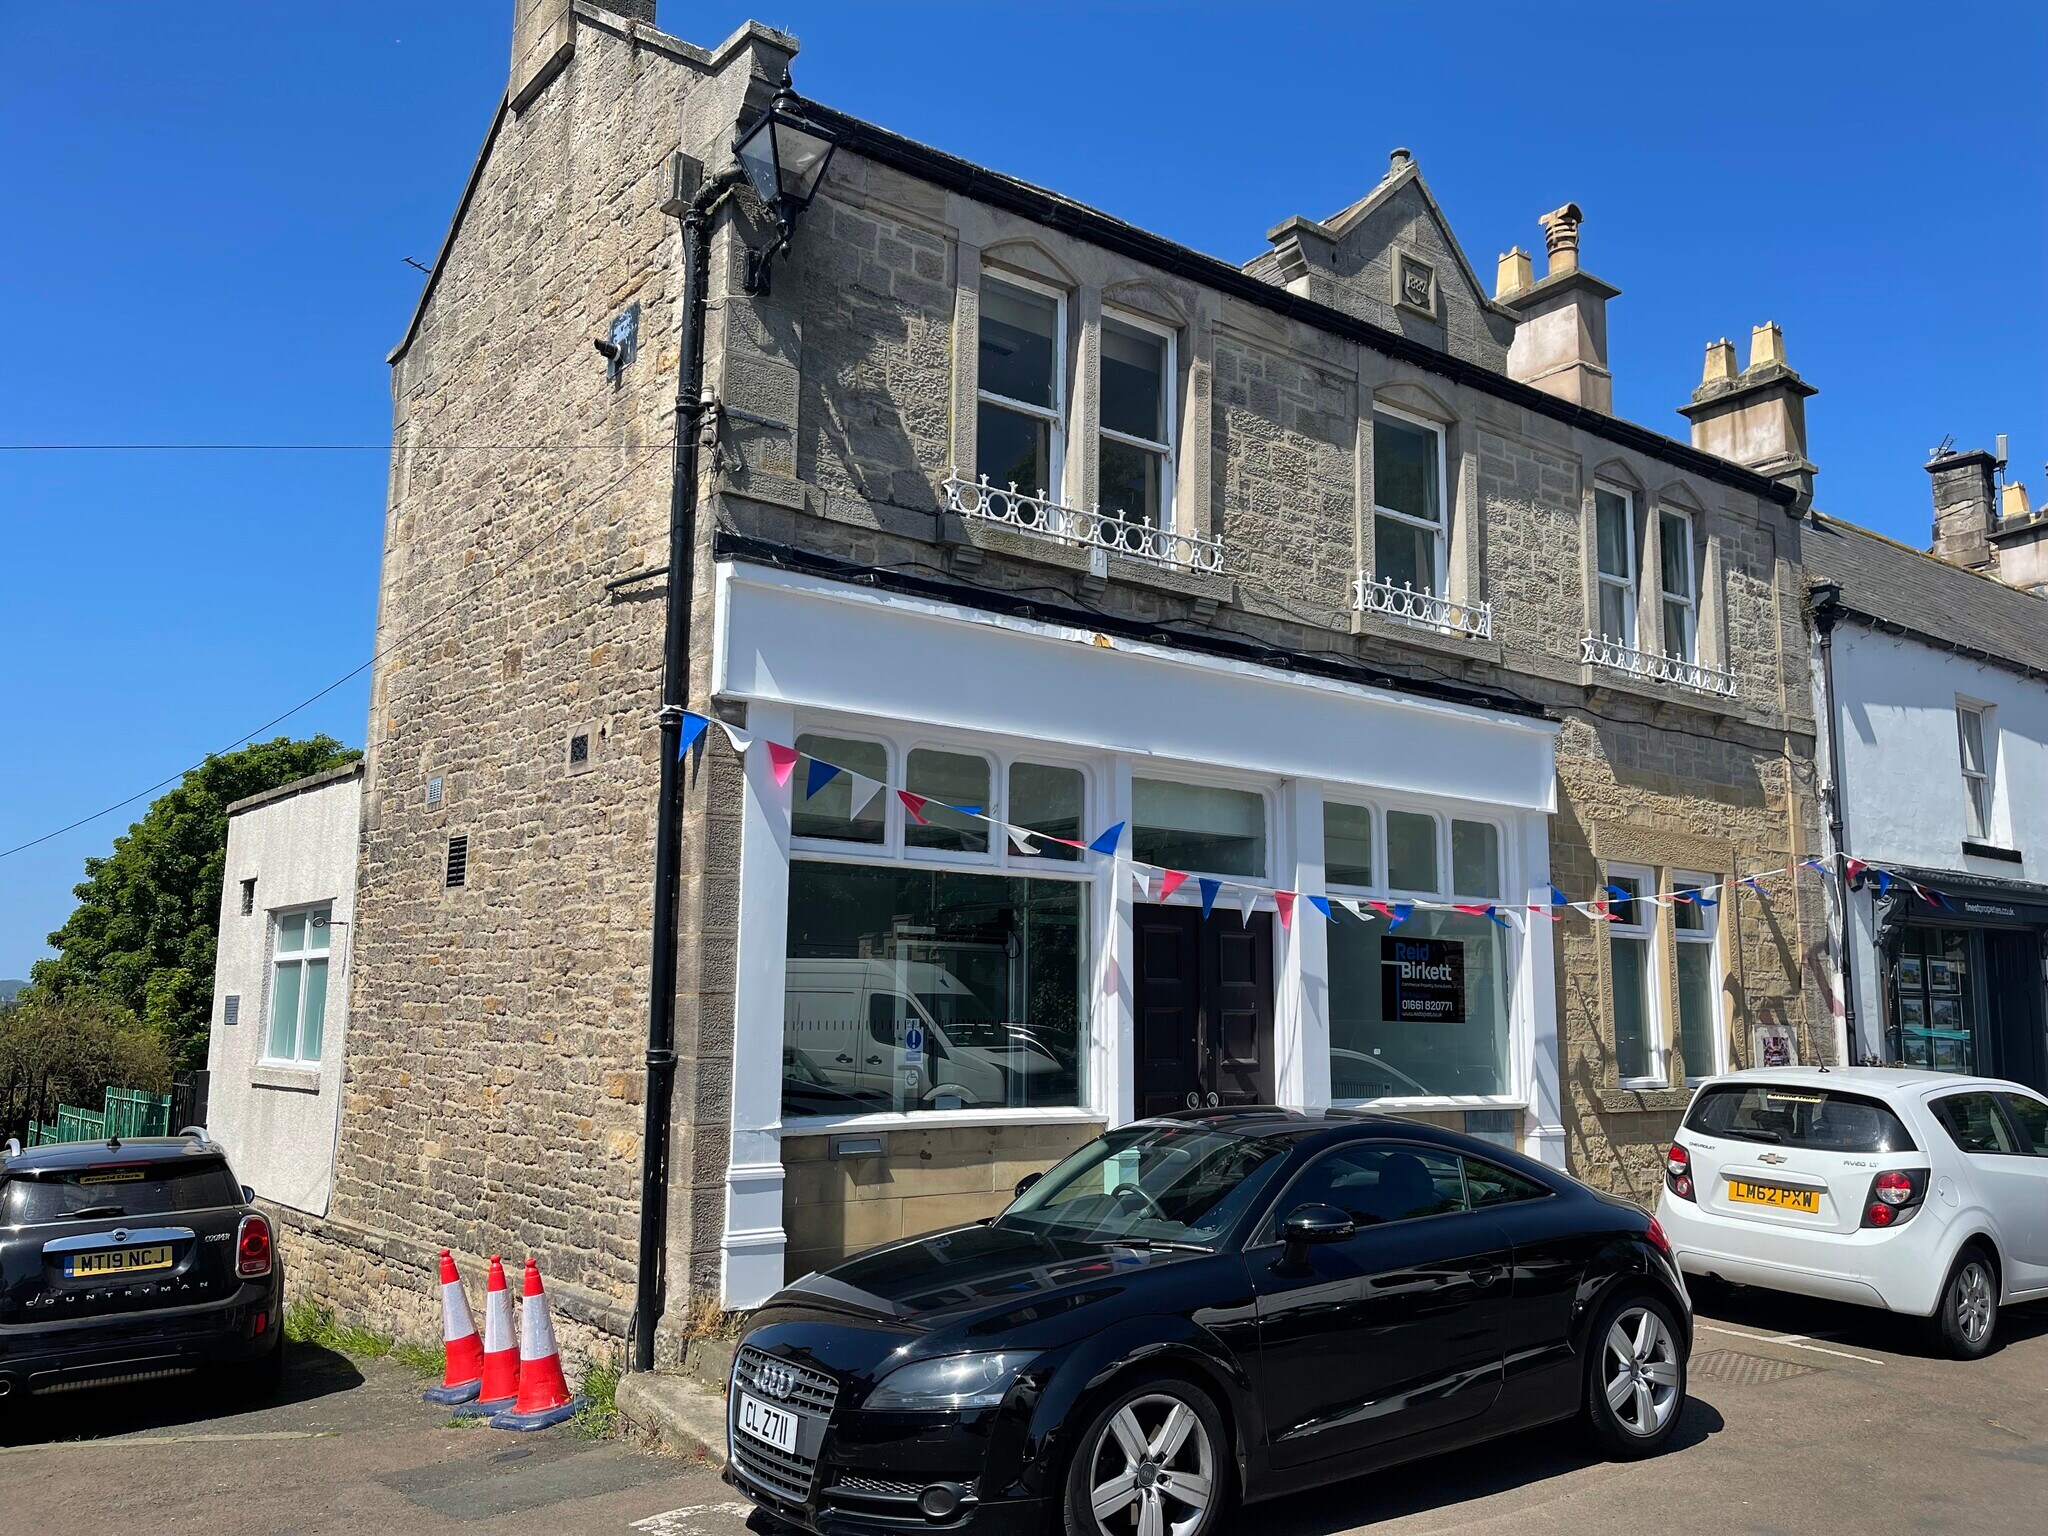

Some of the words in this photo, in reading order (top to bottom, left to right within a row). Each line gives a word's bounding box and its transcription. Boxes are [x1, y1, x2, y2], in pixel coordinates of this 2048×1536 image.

[1094, 550, 1105, 568] H
[1395, 942, 1430, 961] Reid
[1401, 961, 1452, 981] Birkett
[1401, 999, 1424, 1010] 01661
[1424, 1000, 1453, 1011] 820771
[1688, 1141, 1716, 1151] CHEVROLET
[84, 1173, 116, 1183] Arnold
[116, 1172, 141, 1181] Clark
[1736, 1182, 1777, 1203] LM62
[1781, 1190, 1814, 1208] PXW
[205, 1232, 231, 1243] COOPER
[81, 1253, 124, 1273] MT19
[128, 1248, 165, 1267] NCJ
[25, 1281, 209, 1307] COUNTRYMAN
[745, 1401, 759, 1433] CL
